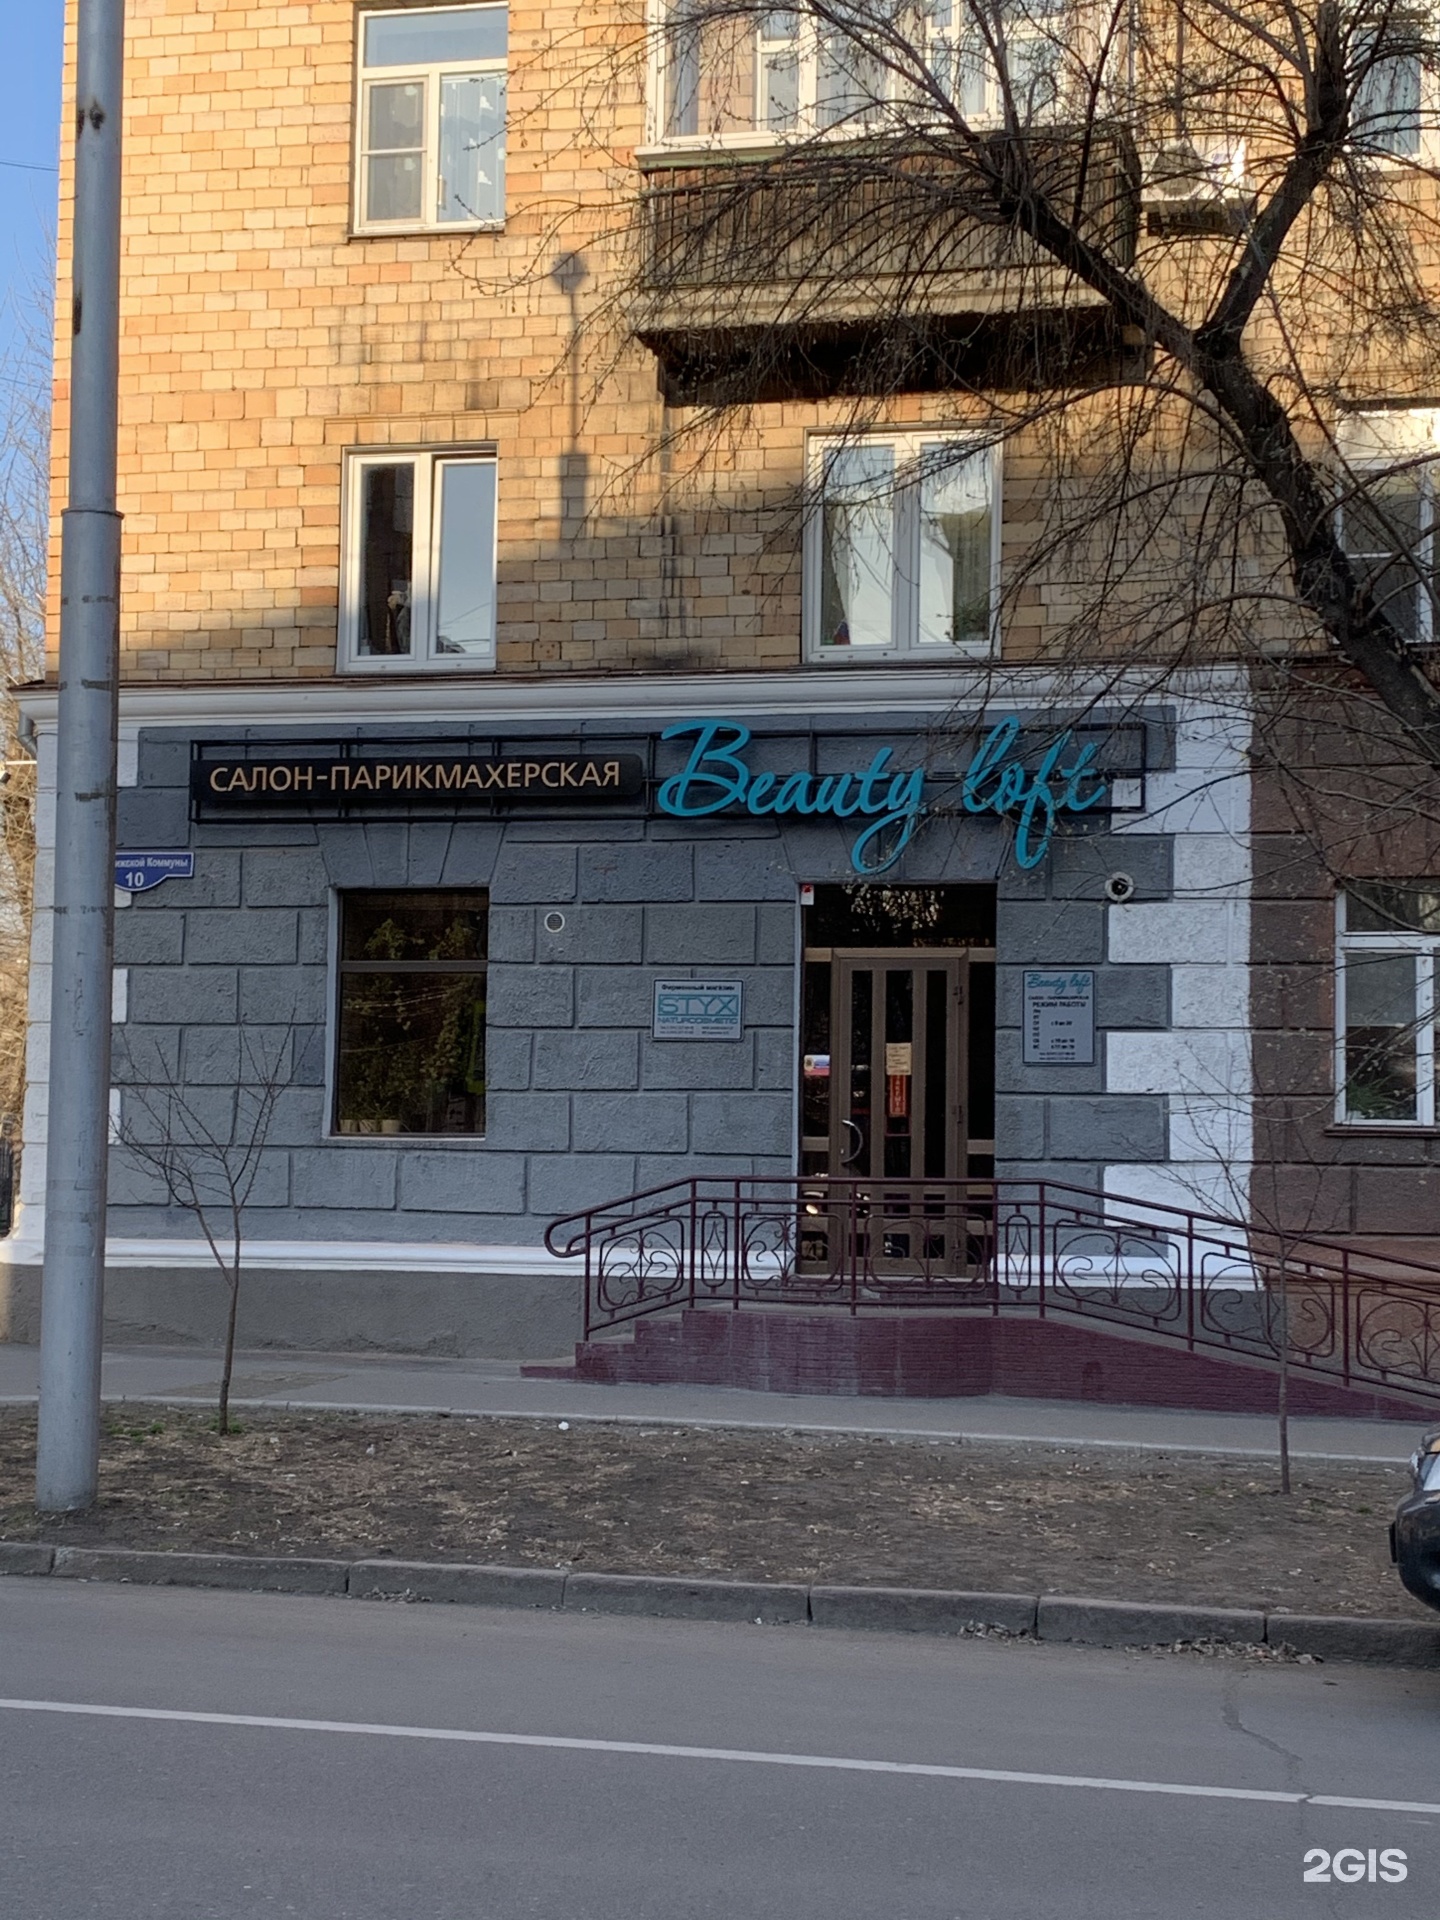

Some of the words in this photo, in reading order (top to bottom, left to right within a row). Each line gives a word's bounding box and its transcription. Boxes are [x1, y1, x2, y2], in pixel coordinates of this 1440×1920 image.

[208, 761, 621, 793] САЛОН-ПАРИКМАХЕРСКАЯ
[658, 719, 927, 876] Beauty
[962, 716, 1107, 870] loft
[115, 857, 145, 868] ижской
[147, 857, 188, 869] Коммуны
[125, 871, 145, 887] 10
[1027, 973, 1067, 995] Beauty
[1069, 973, 1091, 995] loft
[659, 994, 739, 1016] STYX
